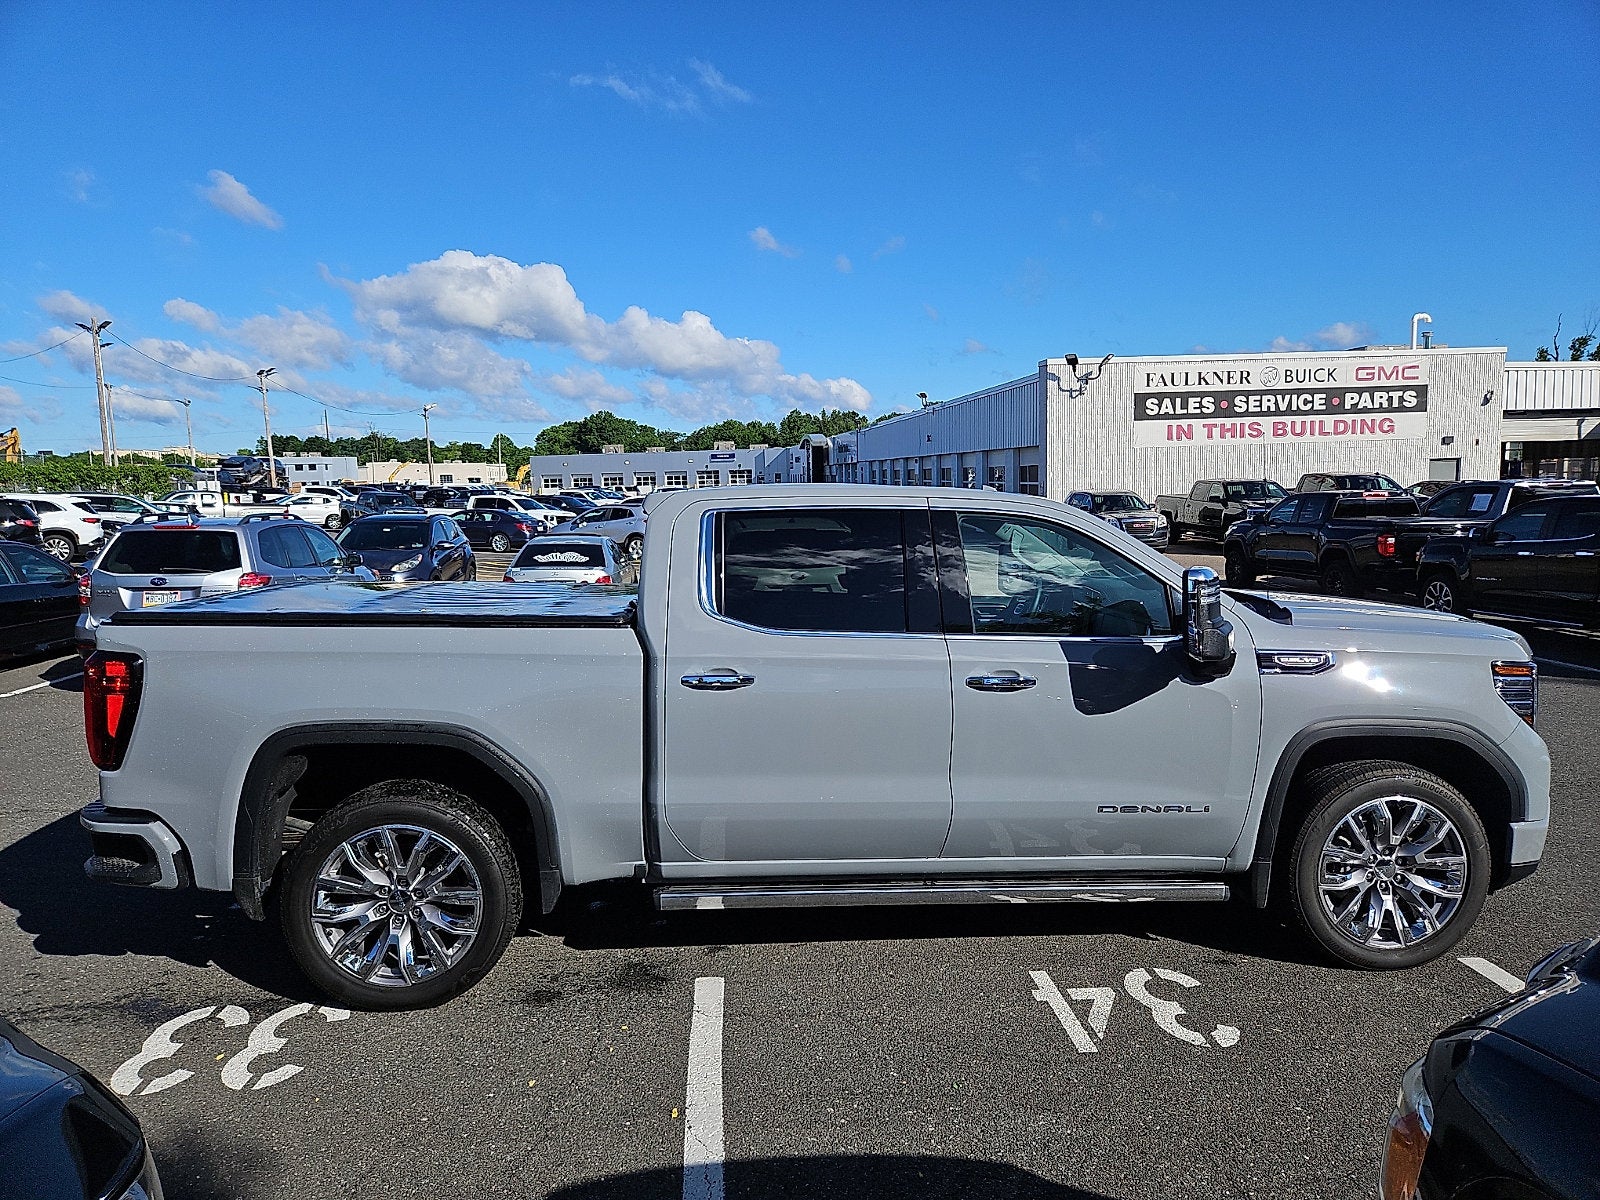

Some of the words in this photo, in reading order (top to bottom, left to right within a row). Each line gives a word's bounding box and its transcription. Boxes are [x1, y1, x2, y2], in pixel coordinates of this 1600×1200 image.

[1145, 370, 1251, 388] FAULKNER
[1284, 367, 1337, 384] BUICK
[1355, 364, 1420, 382] GMC
[1145, 396, 1216, 415] SALES
[1233, 393, 1327, 413] SERVICE
[1344, 390, 1418, 410] PARTS
[1166, 423, 1194, 441] IN
[1202, 421, 1265, 440] THIS
[1272, 417, 1396, 438] BUILDING
[1413, 779, 1465, 811] BRIDGESTONE
[1098, 805, 1210, 814] DENALI
[1029, 967, 1241, 1053] 34
[110, 1003, 350, 1096] 33
